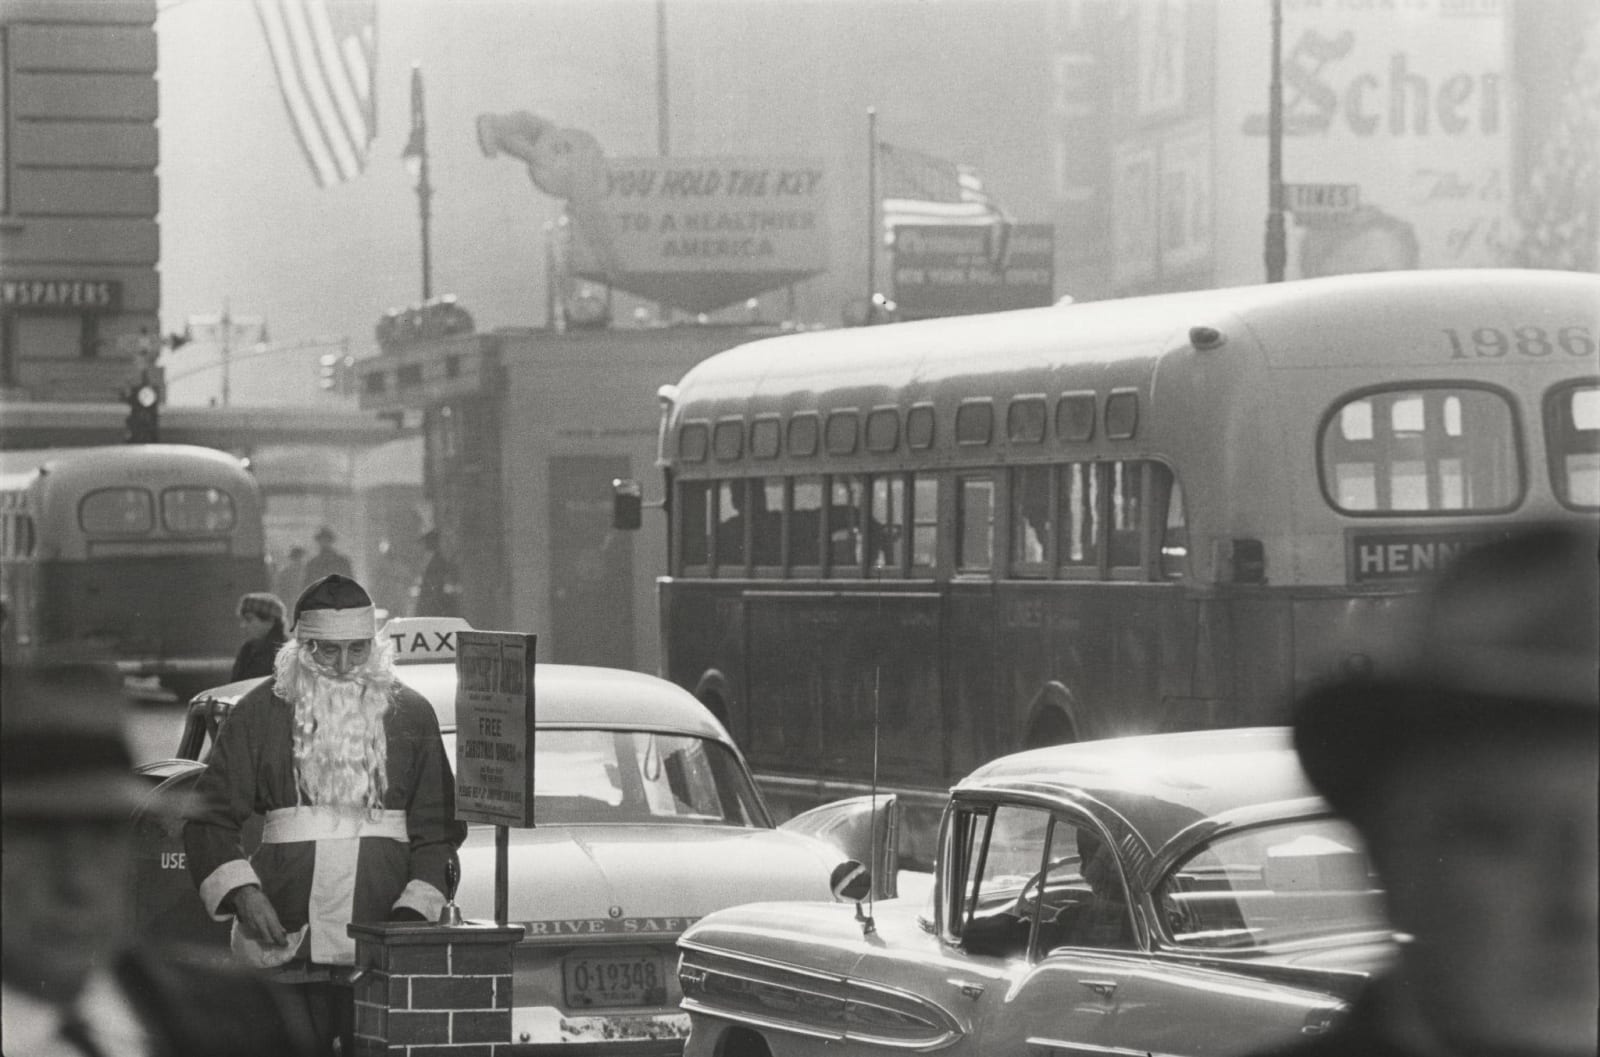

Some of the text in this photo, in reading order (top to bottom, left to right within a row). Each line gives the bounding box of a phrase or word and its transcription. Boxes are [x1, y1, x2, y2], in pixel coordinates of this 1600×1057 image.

[606, 168, 823, 197] YOU HOLD THE KEY
[620, 210, 815, 232] TO A HEALTHIER
[662, 237, 773, 257] AMERICA
[0, 280, 110, 306] WSPAPERS
[1442, 325, 1597, 360] 1986
[479, 716, 503, 738] FREE
[161, 852, 187, 869] USE
